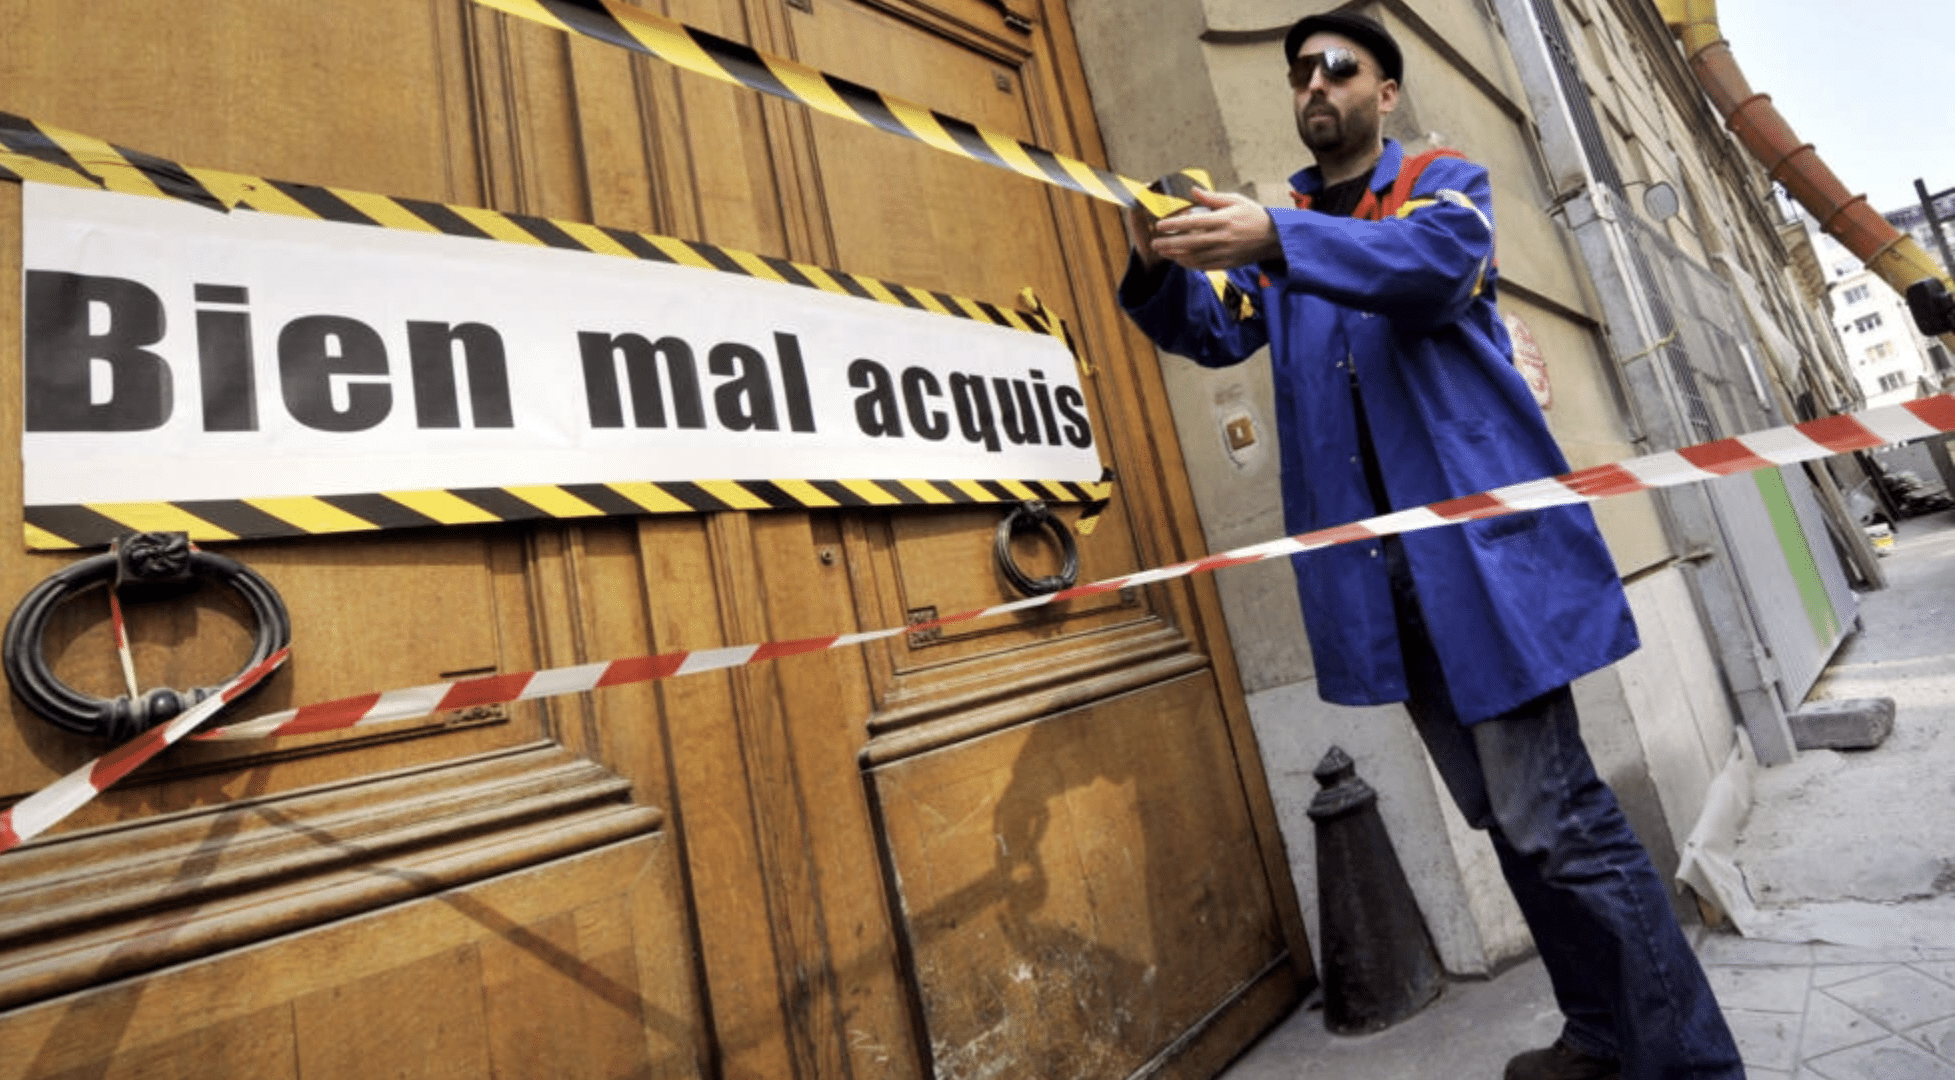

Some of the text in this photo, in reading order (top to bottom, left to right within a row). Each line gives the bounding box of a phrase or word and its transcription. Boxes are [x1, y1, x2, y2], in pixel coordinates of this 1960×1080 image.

[26, 270, 1092, 452] Bien mal acquis
